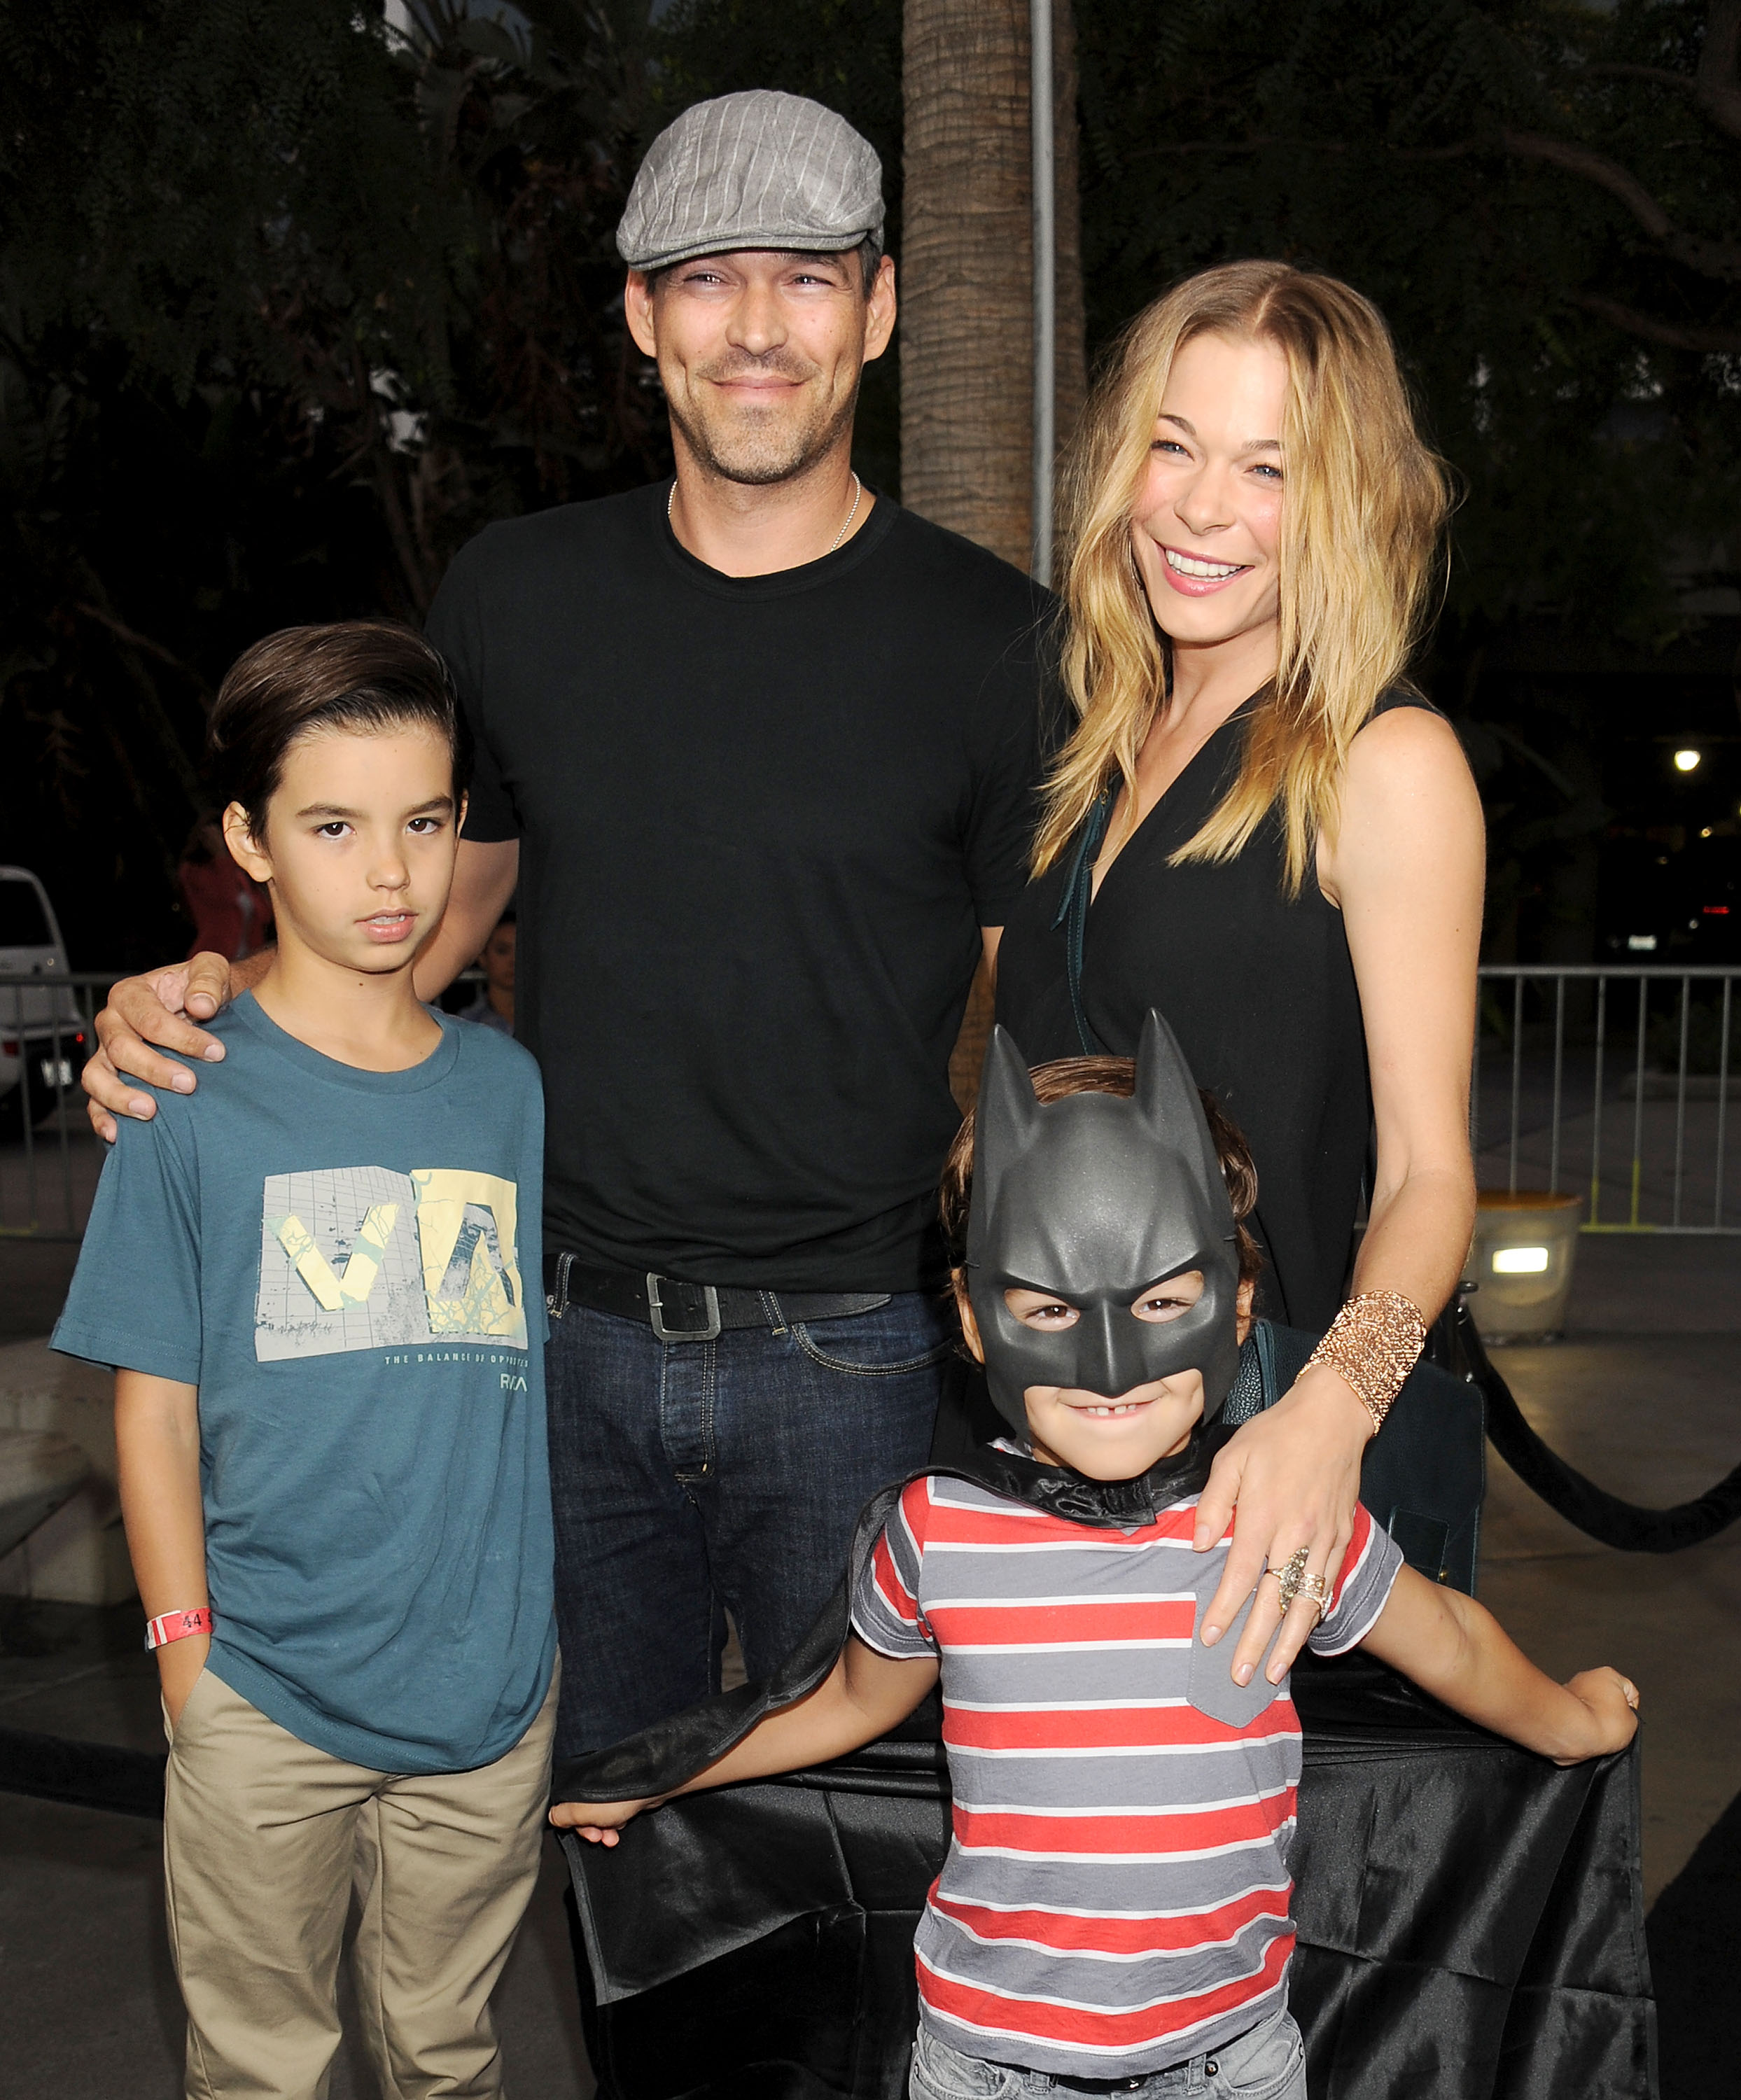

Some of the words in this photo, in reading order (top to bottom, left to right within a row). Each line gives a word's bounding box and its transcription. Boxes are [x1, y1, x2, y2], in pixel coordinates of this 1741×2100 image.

[384, 1354, 409, 1365] THE
[417, 1352, 470, 1363] BALANCE
[475, 1354, 485, 1363] OF
[490, 1354, 529, 1367] OPPOSTES
